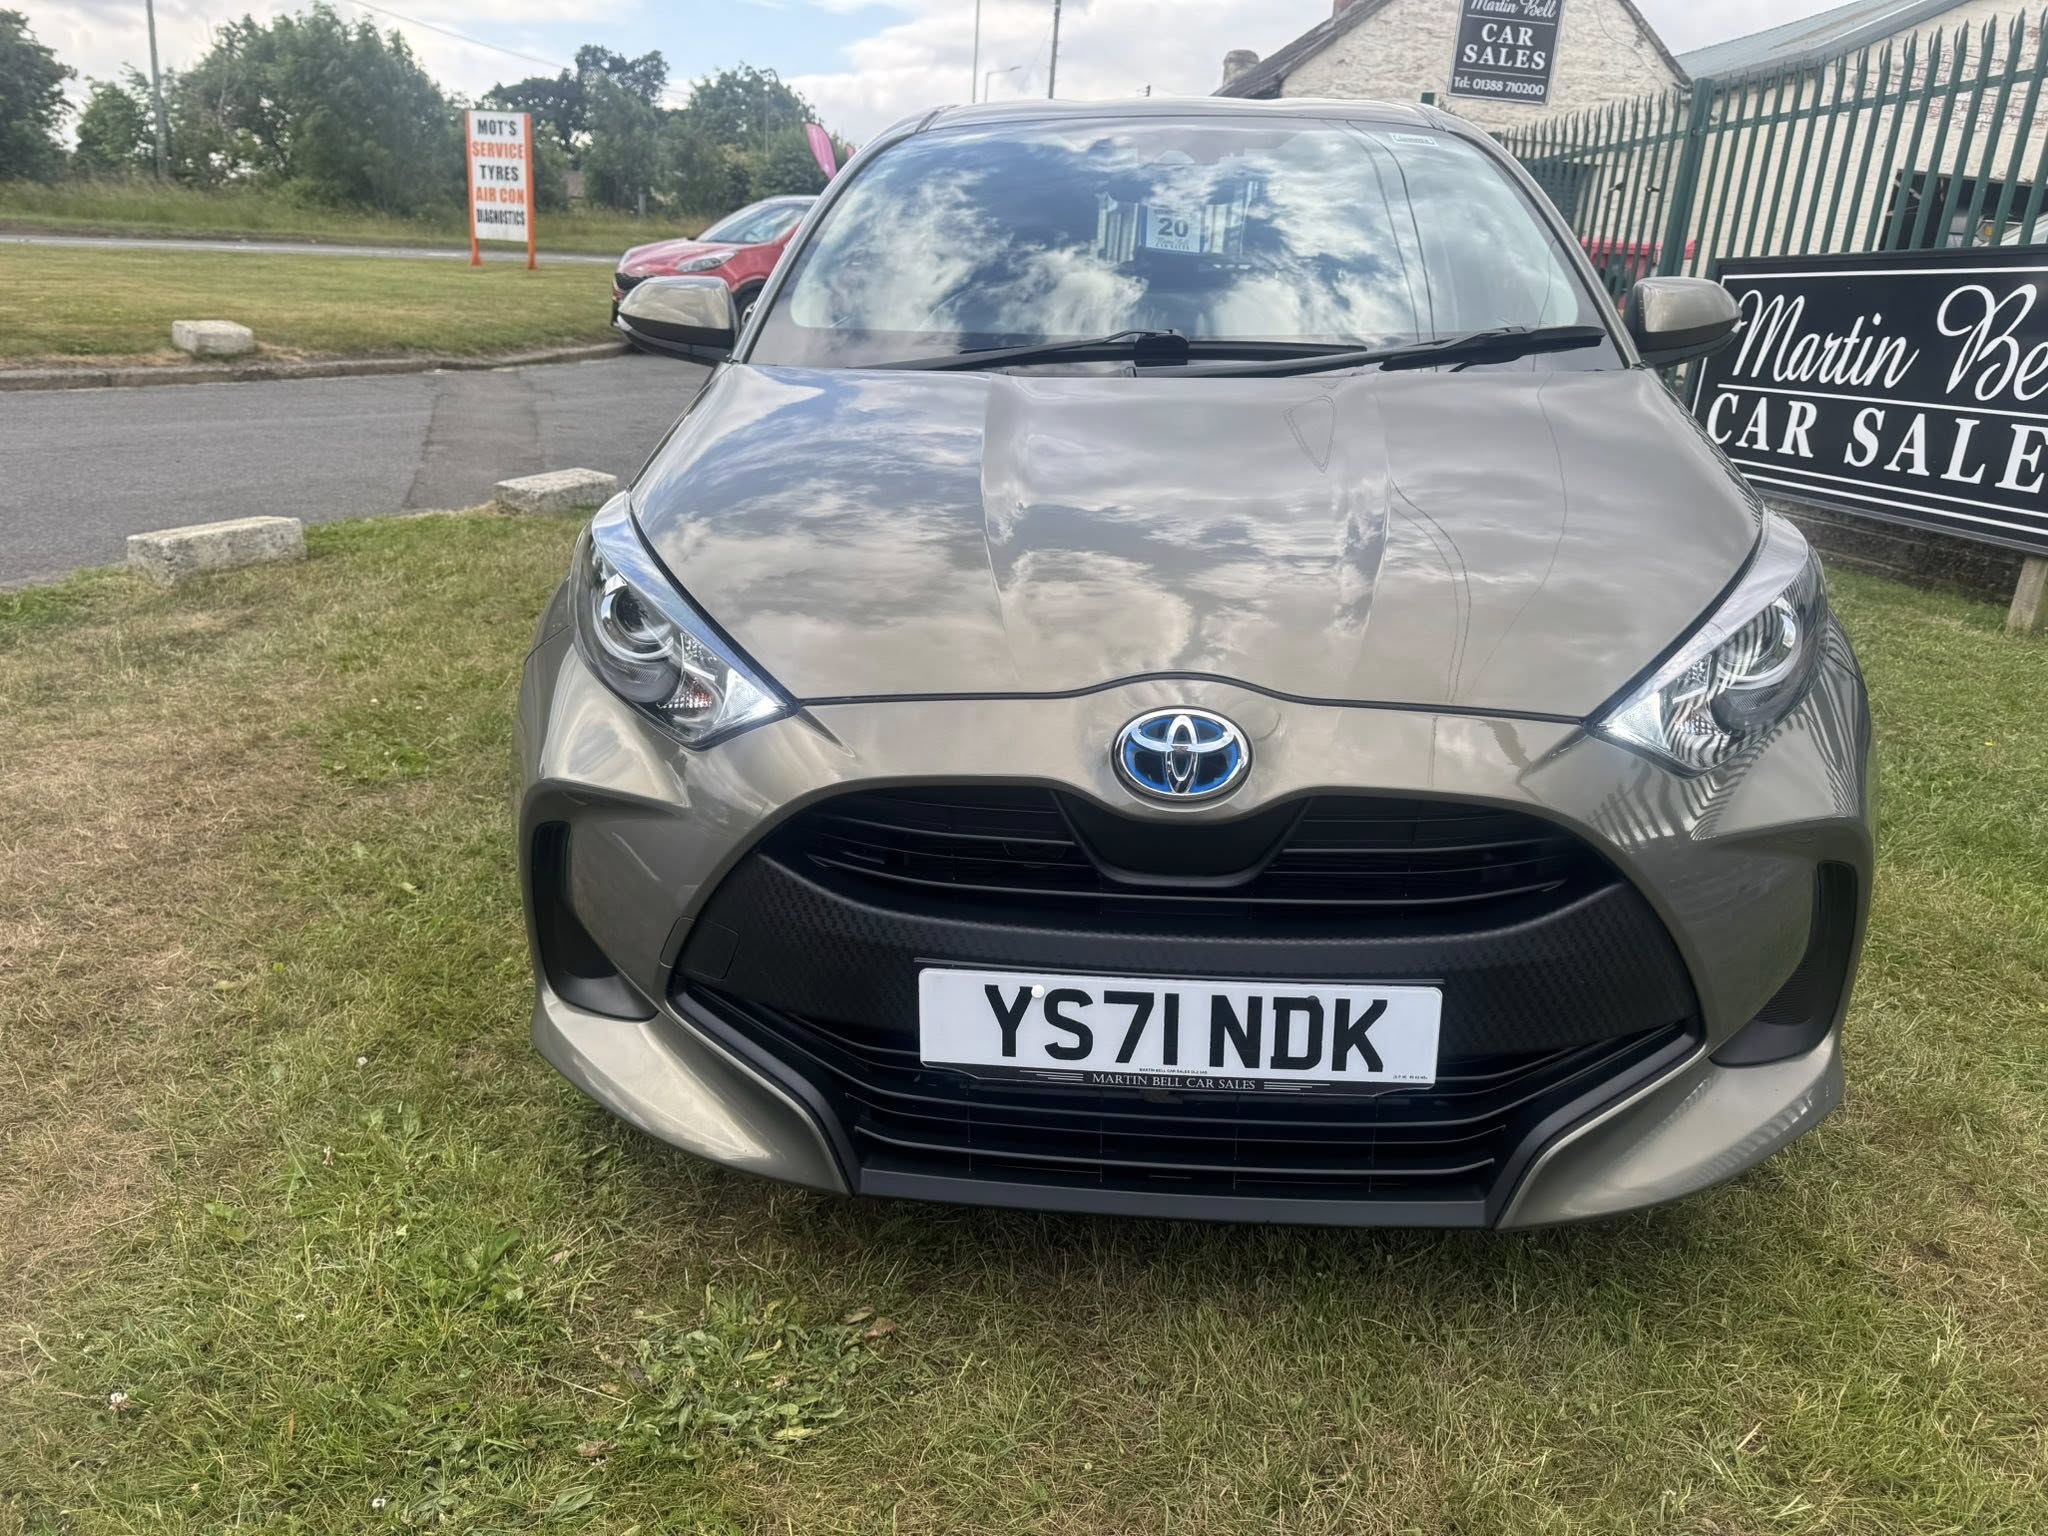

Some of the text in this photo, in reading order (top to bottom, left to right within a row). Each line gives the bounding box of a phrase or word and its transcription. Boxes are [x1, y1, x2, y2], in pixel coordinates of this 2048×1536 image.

[1520, 0, 1556, 17] Bell
[1481, 23, 1534, 46] CAR
[1463, 44, 1546, 70] SALES
[1472, 78, 1504, 91] 01388
[1505, 81, 1544, 95] 710200
[477, 119, 517, 136] MOT'S
[472, 142, 524, 159] SERVICE
[480, 165, 519, 181] TYRES
[476, 187, 525, 204] AIR CON
[477, 208, 526, 226] DIAGNOSTICS
[1158, 217, 1188, 238] 20
[1732, 289, 1919, 389] Martin
[1707, 392, 2048, 494] CAR SALE
[984, 984, 1389, 1073] YS71 NDK
[1092, 1073, 1256, 1090] MARTIN BELL CAR SALES
